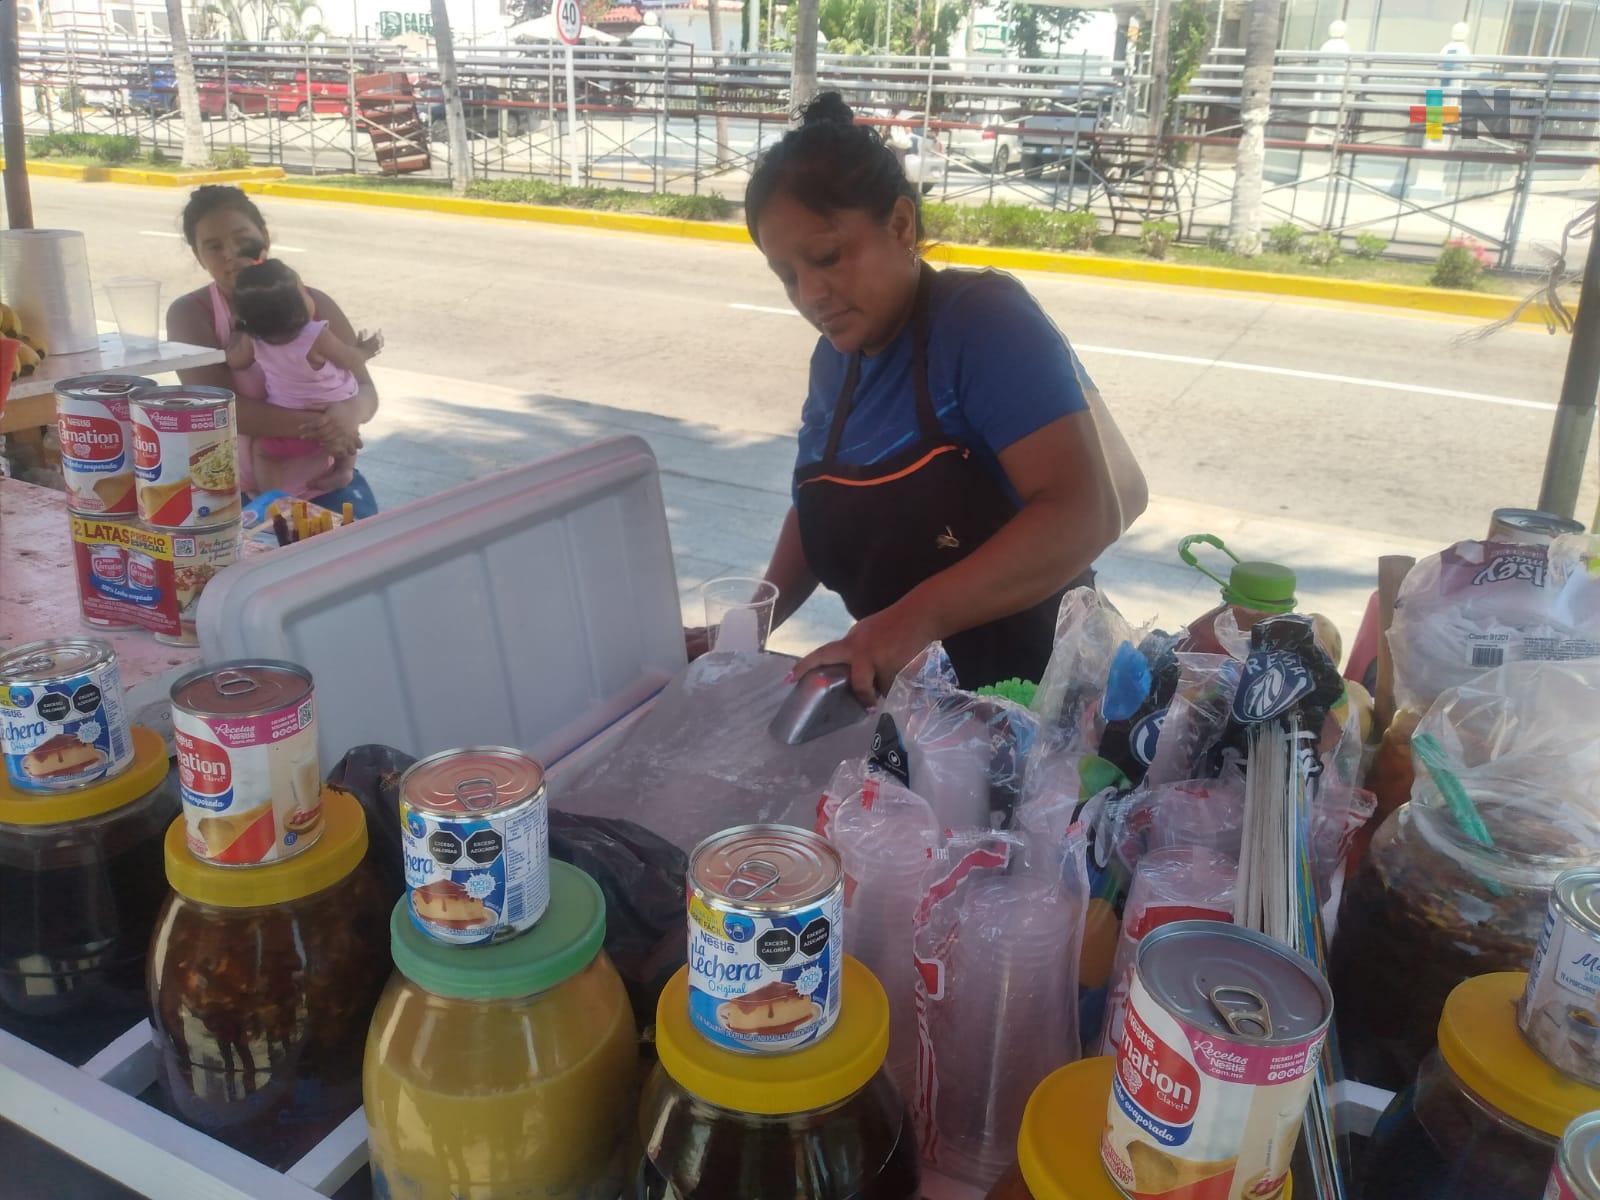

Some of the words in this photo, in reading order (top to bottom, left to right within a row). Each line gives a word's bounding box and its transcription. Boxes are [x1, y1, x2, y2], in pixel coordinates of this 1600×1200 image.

[561, 2, 577, 25] 40
[84, 522, 130, 545] LATAS
[695, 936, 706, 956] La
[701, 929, 737, 954] Nestlé
[764, 939, 788, 947] EXCESO
[691, 942, 763, 982] Lechera
[708, 979, 747, 999] Original
[1193, 1040, 1249, 1066] Recetas
[1209, 1058, 1246, 1074] Nestlé
[1125, 1100, 1176, 1142] evaporada
